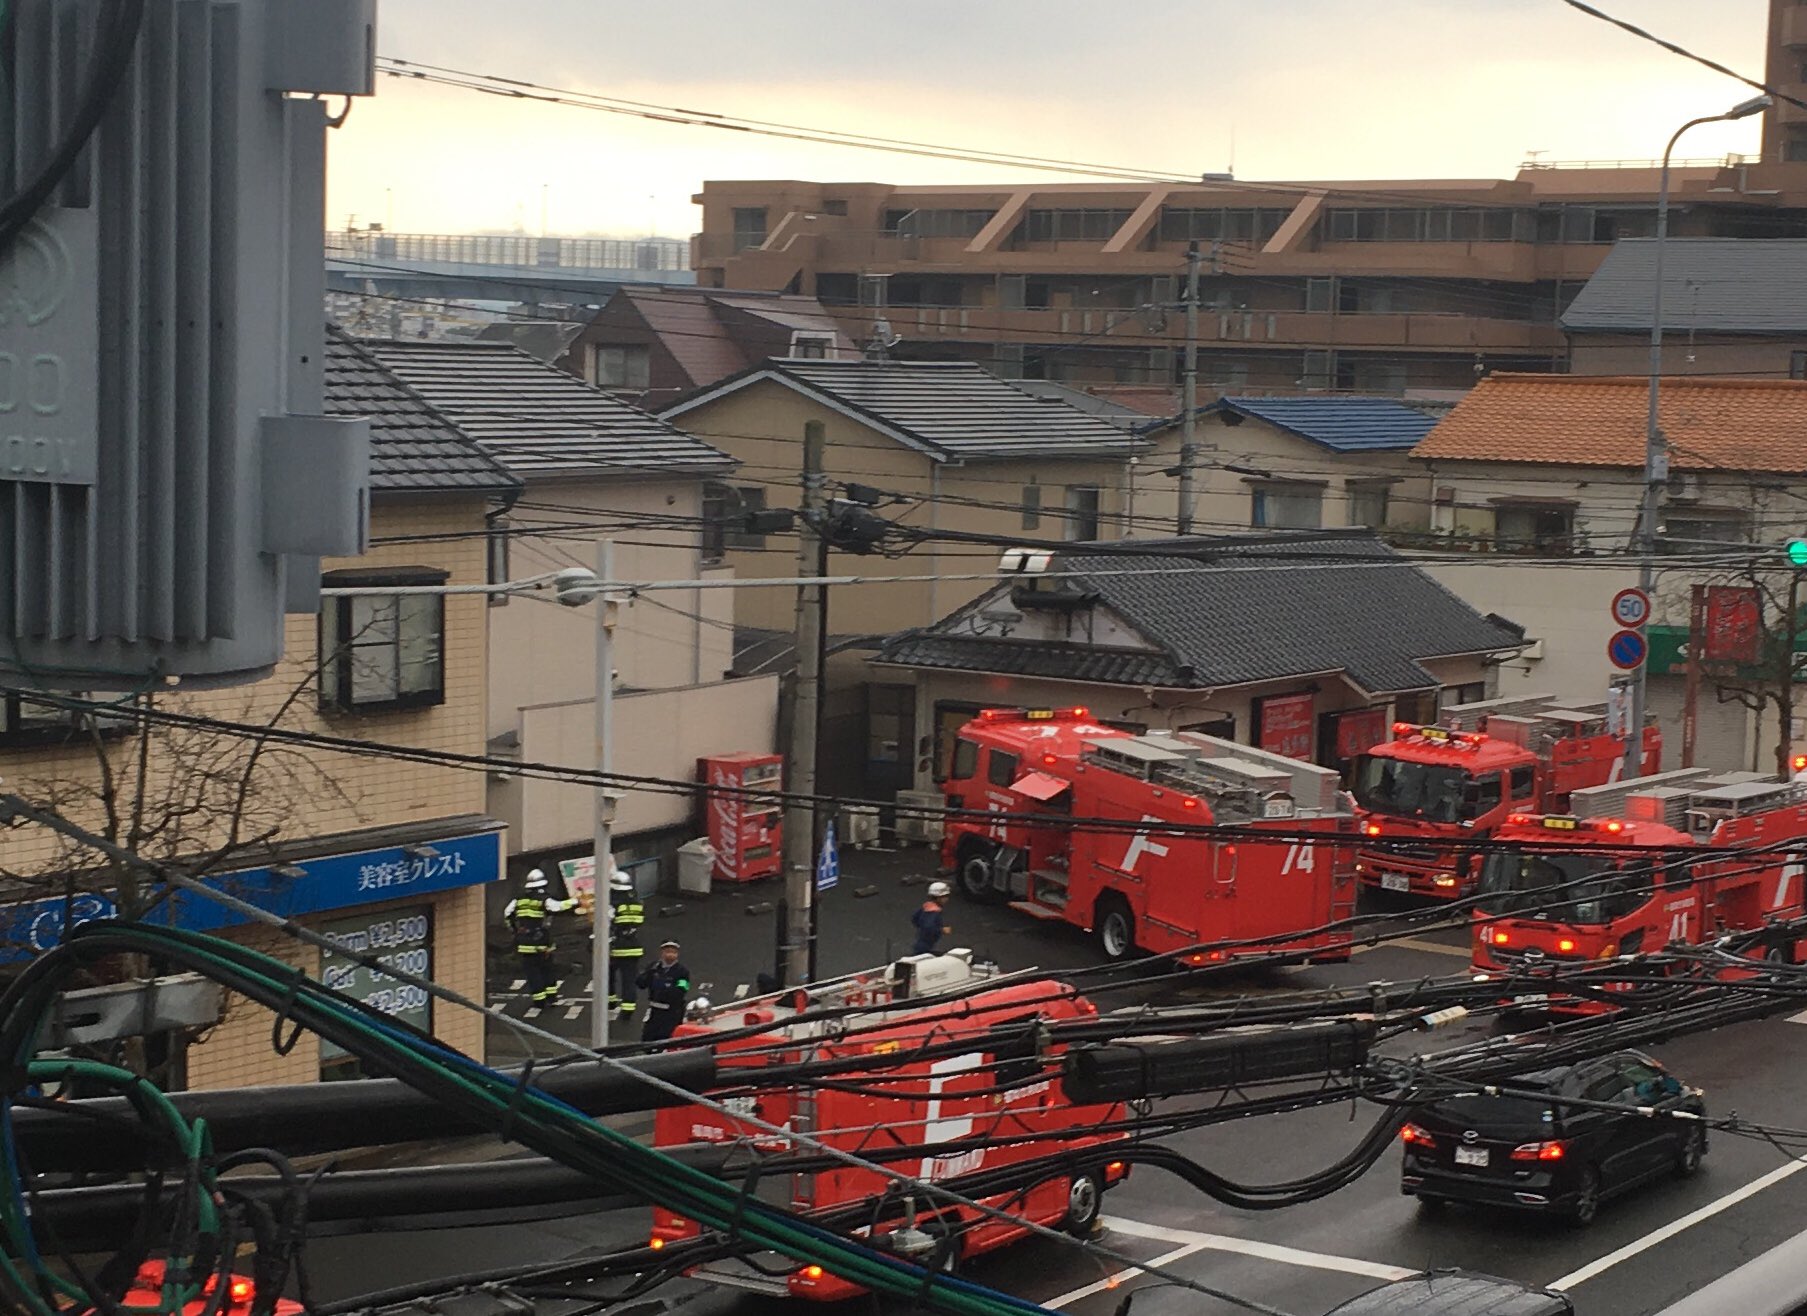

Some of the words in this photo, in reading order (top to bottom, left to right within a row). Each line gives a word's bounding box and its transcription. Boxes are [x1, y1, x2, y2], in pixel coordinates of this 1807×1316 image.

[1620, 599, 1642, 617] 50
[1280, 837, 1315, 875] 74
[358, 852, 466, 892] 美容室クレスト
[1479, 926, 1494, 944] 41
